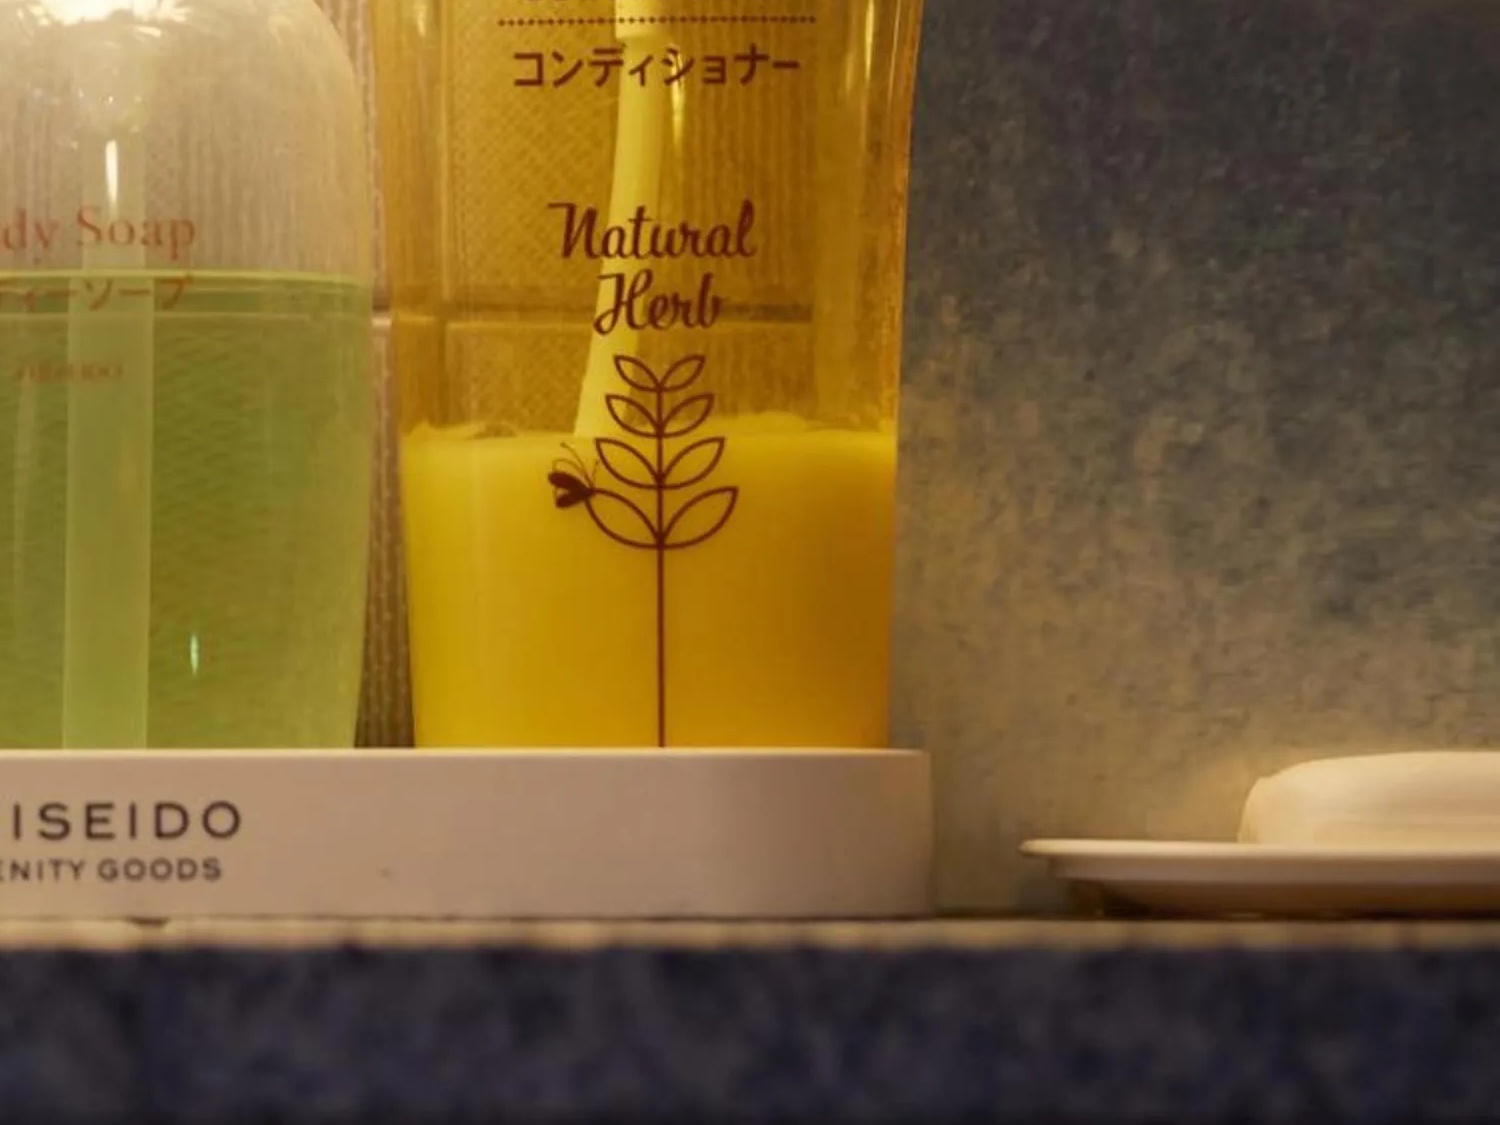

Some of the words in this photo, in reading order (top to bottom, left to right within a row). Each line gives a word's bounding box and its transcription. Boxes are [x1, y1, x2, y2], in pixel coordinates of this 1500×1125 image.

[512, 42, 800, 88] コンディショナー
[75, 204, 197, 262] Soap
[546, 197, 758, 261] Natural
[592, 267, 726, 337] Herb
[96, 856, 224, 883] GOODS
